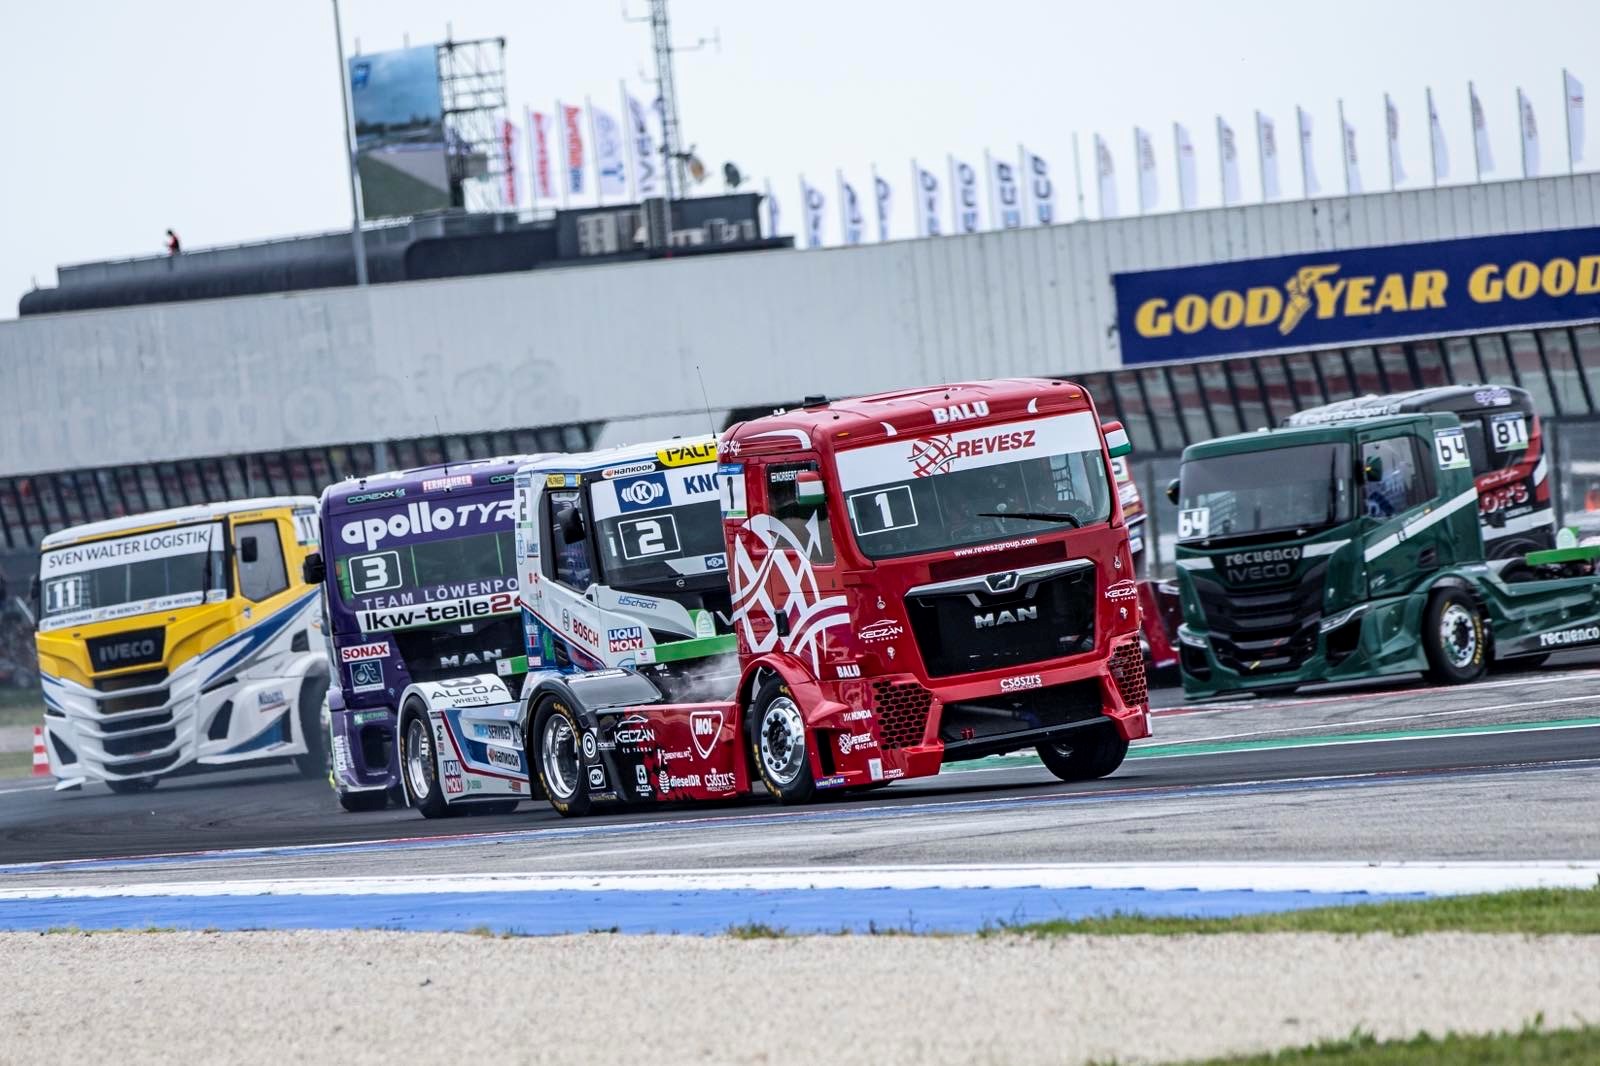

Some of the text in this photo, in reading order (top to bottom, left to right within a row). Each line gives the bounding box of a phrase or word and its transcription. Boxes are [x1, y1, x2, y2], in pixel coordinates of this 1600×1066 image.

[1135, 263, 1448, 338] GOODYEAR
[932, 400, 990, 425] BALU
[956, 430, 1036, 458] REVESZ
[1496, 420, 1522, 444] 81
[1438, 437, 1468, 462] 64
[423, 475, 472, 491] FERNFAHRER
[727, 477, 735, 510] 1
[519, 489, 527, 521] 2
[874, 493, 894, 528] 1
[341, 501, 455, 551] apollo
[635, 520, 666, 555] 2
[49, 529, 209, 569] SVEN WALTER LOGISTIK
[953, 537, 1038, 558] www.reveszgroup.com
[1225, 548, 1300, 567] recuenco
[362, 556, 389, 589] 3
[1227, 563, 1290, 582] IVECO
[54, 579, 76, 610] 11
[363, 577, 518, 611] TEAM LÖWENPO
[974, 605, 1038, 629] MAN
[572, 618, 599, 648] BOSCH
[609, 627, 641, 641] LIQUI
[1540, 626, 1600, 646] recuenco
[100, 640, 155, 662] IVECO
[342, 643, 388, 661] SONAX
[610, 639, 642, 652] MOLY
[440, 648, 503, 669] MAN
[836, 664, 861, 678] BALU
[431, 684, 506, 700] ALCOA
[454, 695, 490, 705] WHEELS
[446, 777, 463, 793] MOLY
